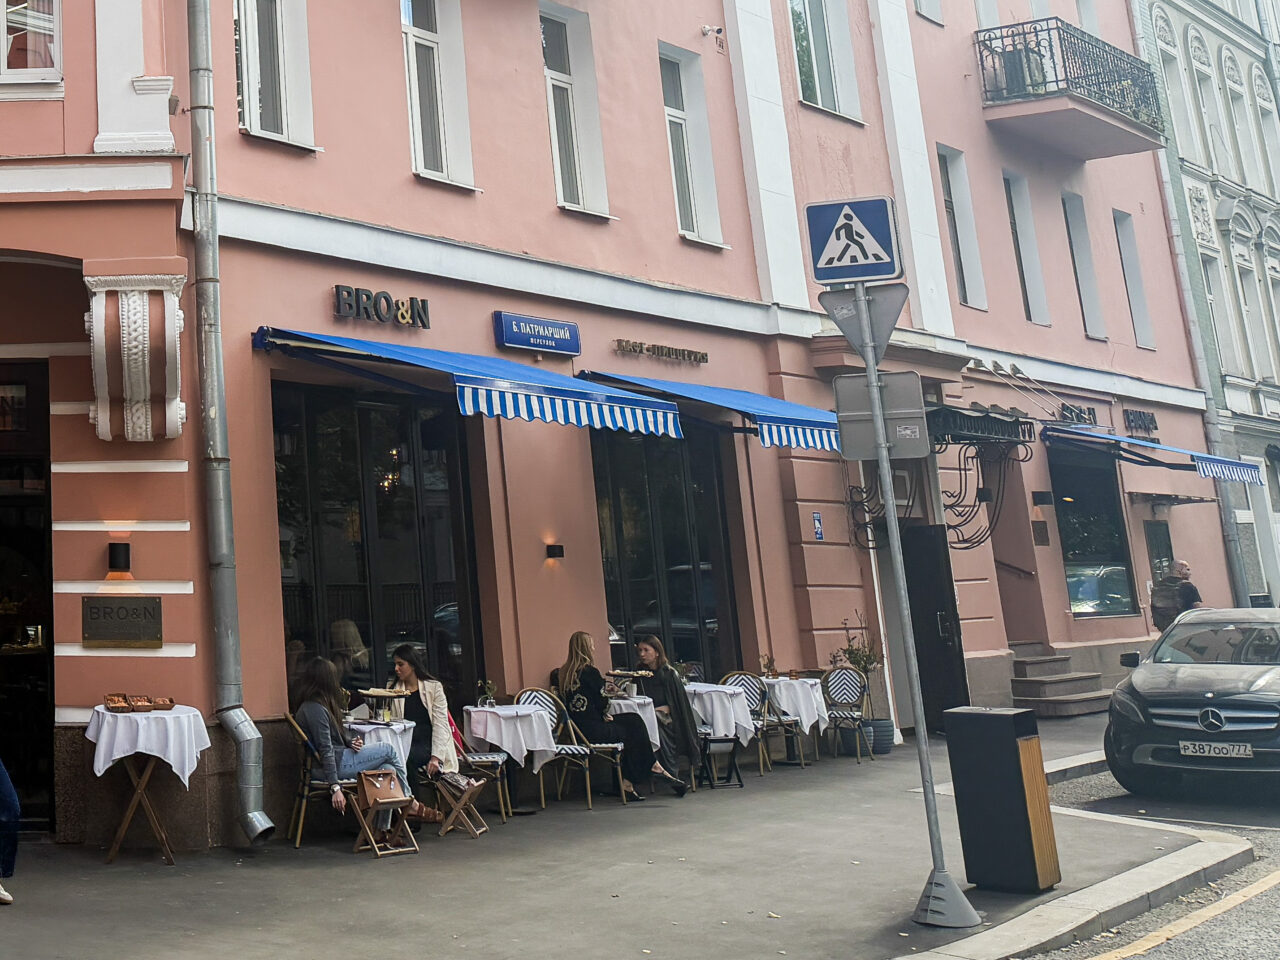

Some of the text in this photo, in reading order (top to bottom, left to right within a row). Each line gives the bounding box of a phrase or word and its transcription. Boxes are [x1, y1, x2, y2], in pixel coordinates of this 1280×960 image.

[334, 284, 431, 330] BRO&N
[512, 320, 571, 340] Б. ПАТРИАРШИЙ
[89, 606, 155, 620] BRO&N
